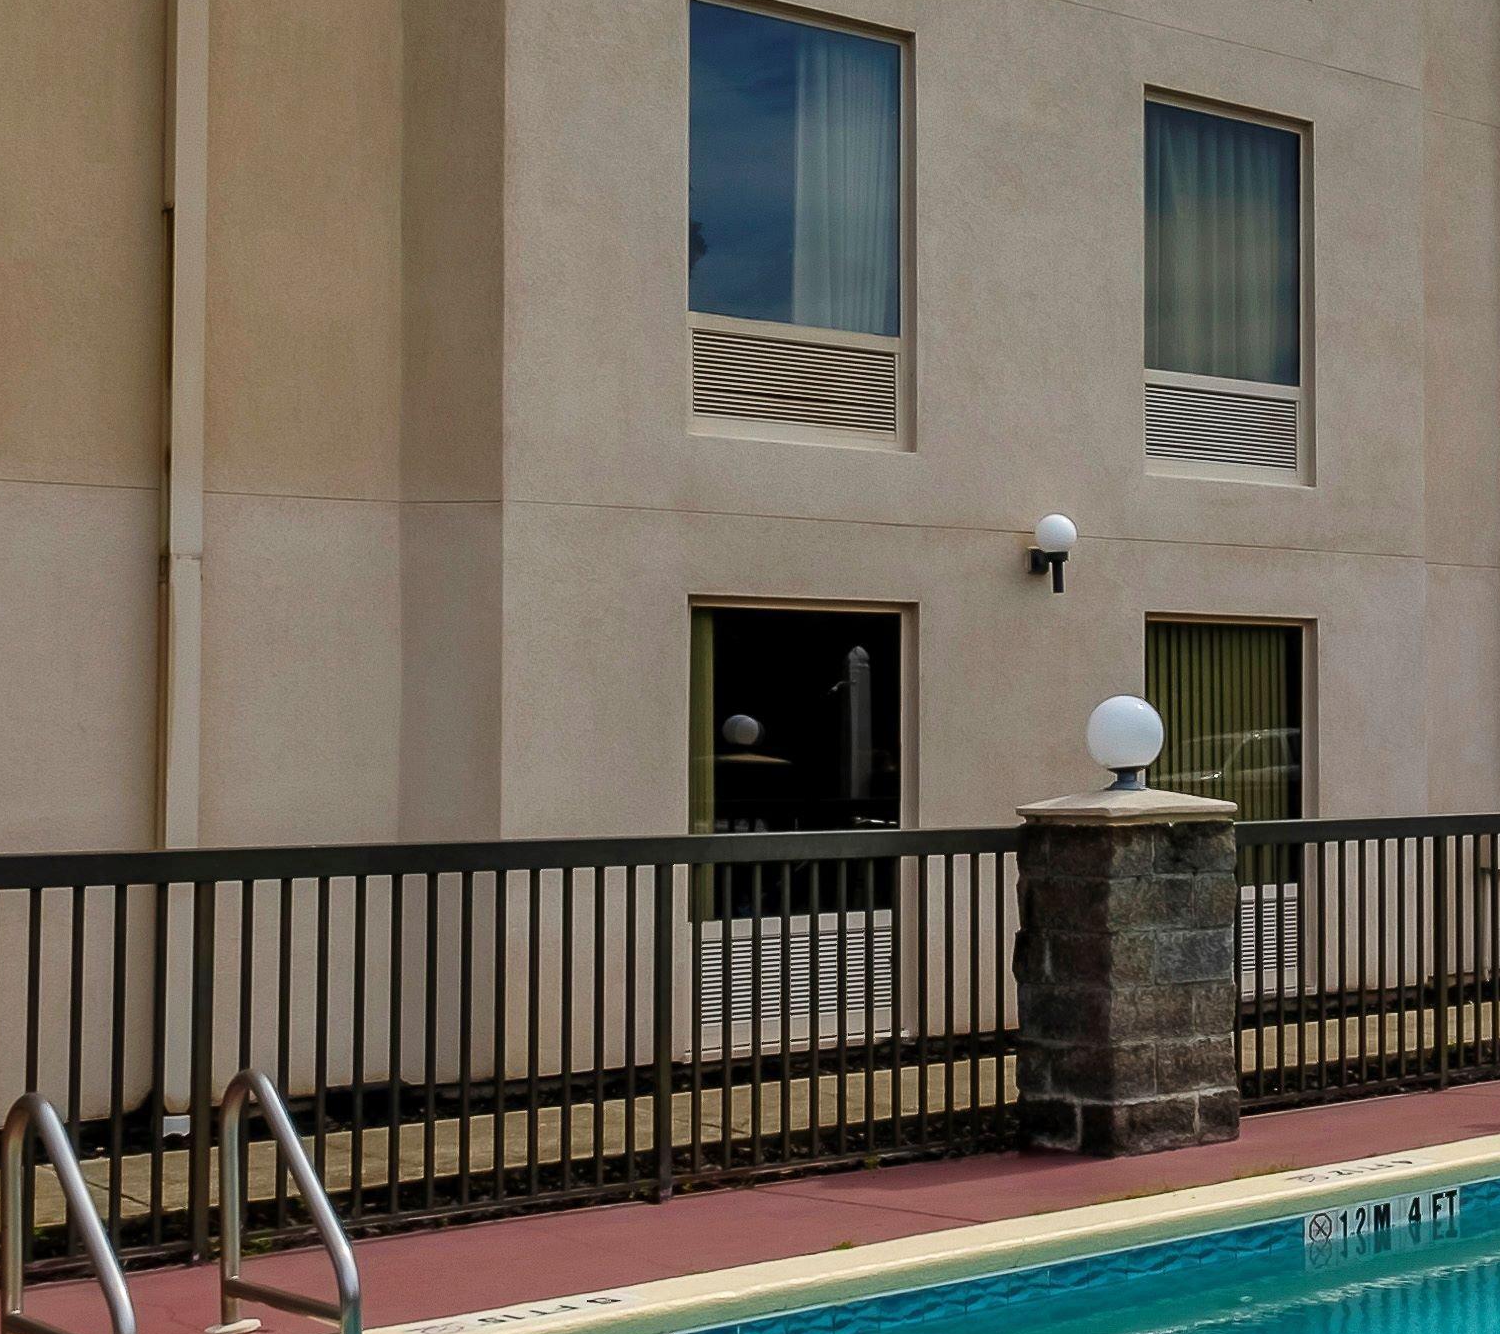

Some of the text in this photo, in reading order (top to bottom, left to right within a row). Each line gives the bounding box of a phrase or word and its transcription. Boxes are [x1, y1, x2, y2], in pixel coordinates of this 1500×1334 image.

[1373, 1203, 1391, 1231] M
[1409, 1197, 1422, 1223] 4
[1433, 1189, 1457, 1220] FT
